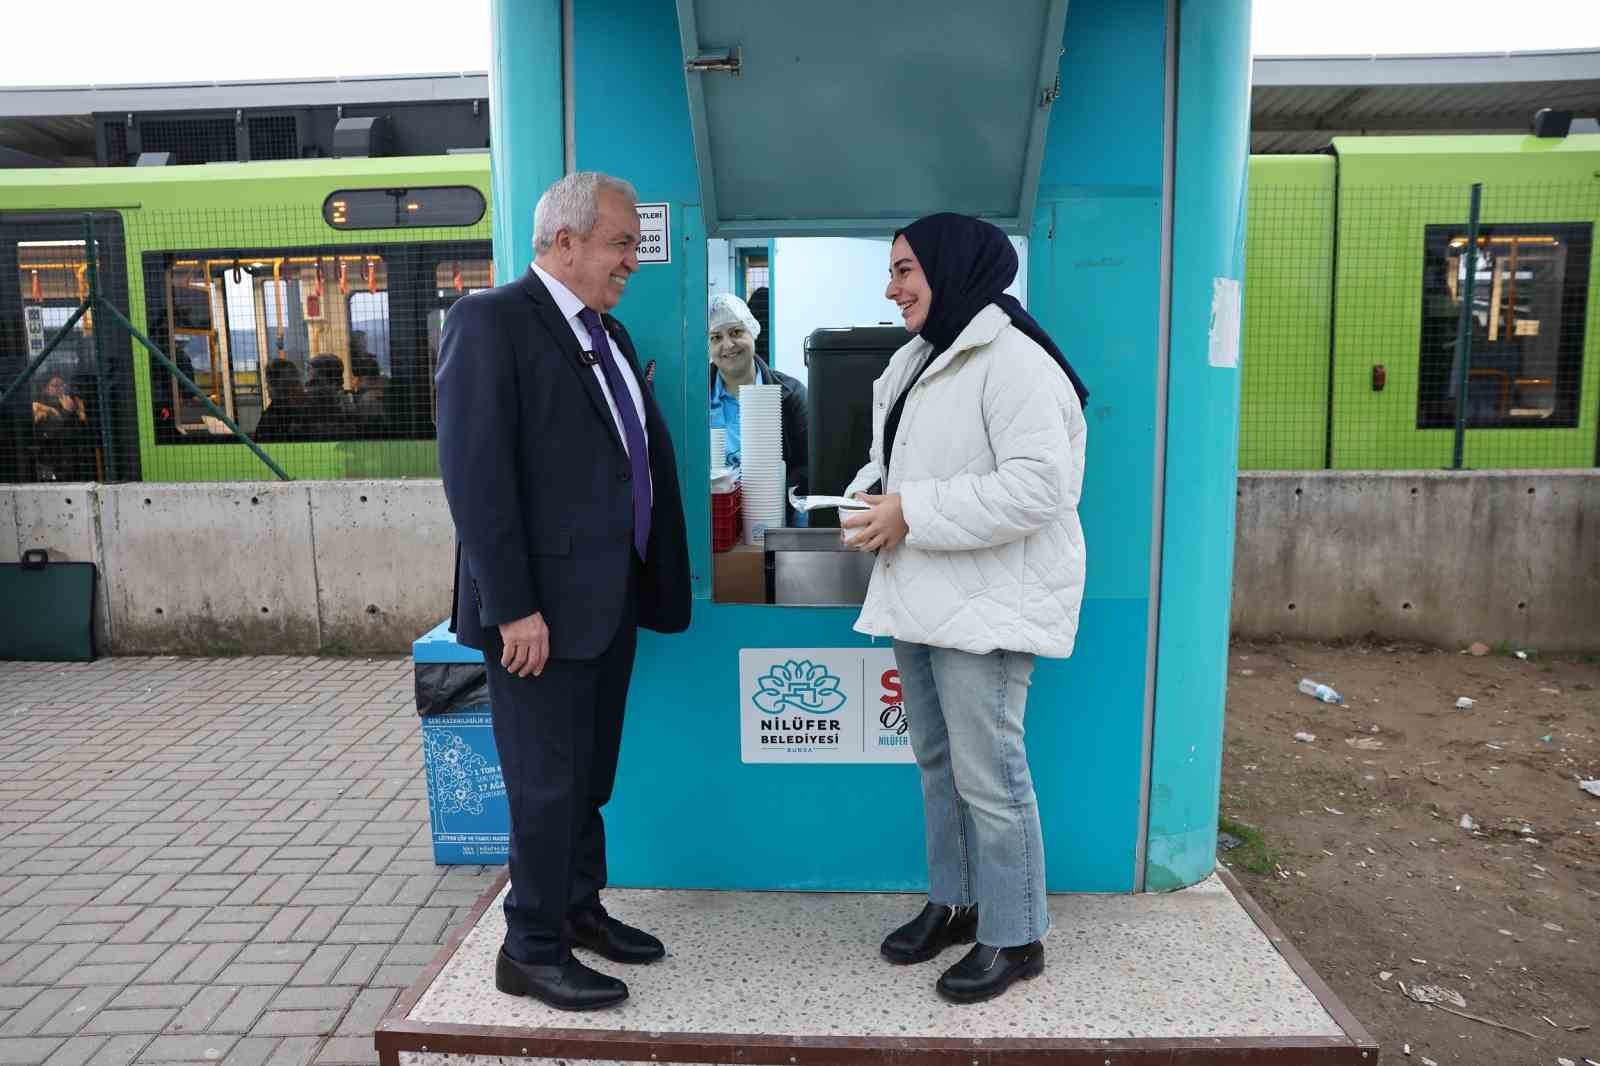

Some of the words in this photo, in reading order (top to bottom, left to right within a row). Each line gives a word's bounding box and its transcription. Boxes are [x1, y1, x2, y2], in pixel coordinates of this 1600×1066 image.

[640, 234, 661, 242] 8.00
[760, 717, 841, 731] NİLÜFER
[760, 733, 839, 744] BELEDİYESİ
